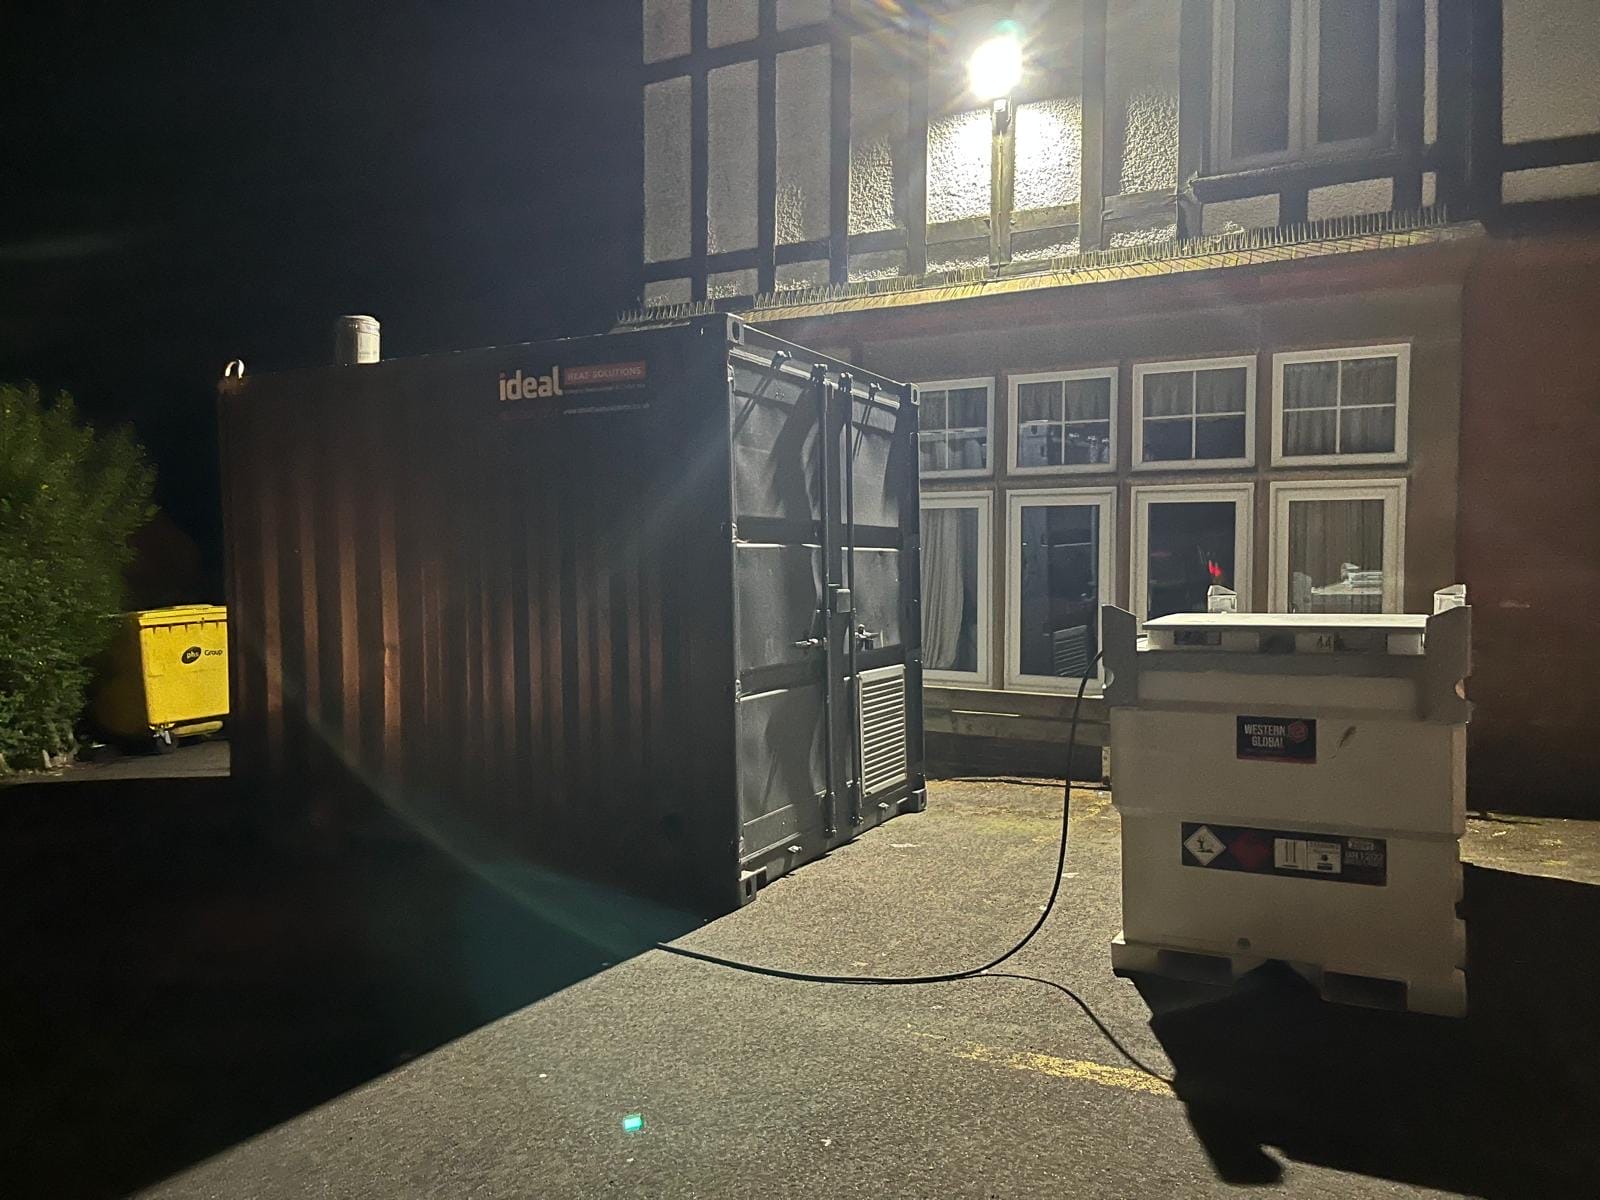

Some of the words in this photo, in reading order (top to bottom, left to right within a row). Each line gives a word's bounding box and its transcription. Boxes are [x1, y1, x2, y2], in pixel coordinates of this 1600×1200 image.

[592, 366, 642, 379] SOLUTIONS
[498, 364, 564, 401] ideal
[1244, 723, 1286, 736] WESTERN
[1251, 735, 1285, 748] GLOBAL
